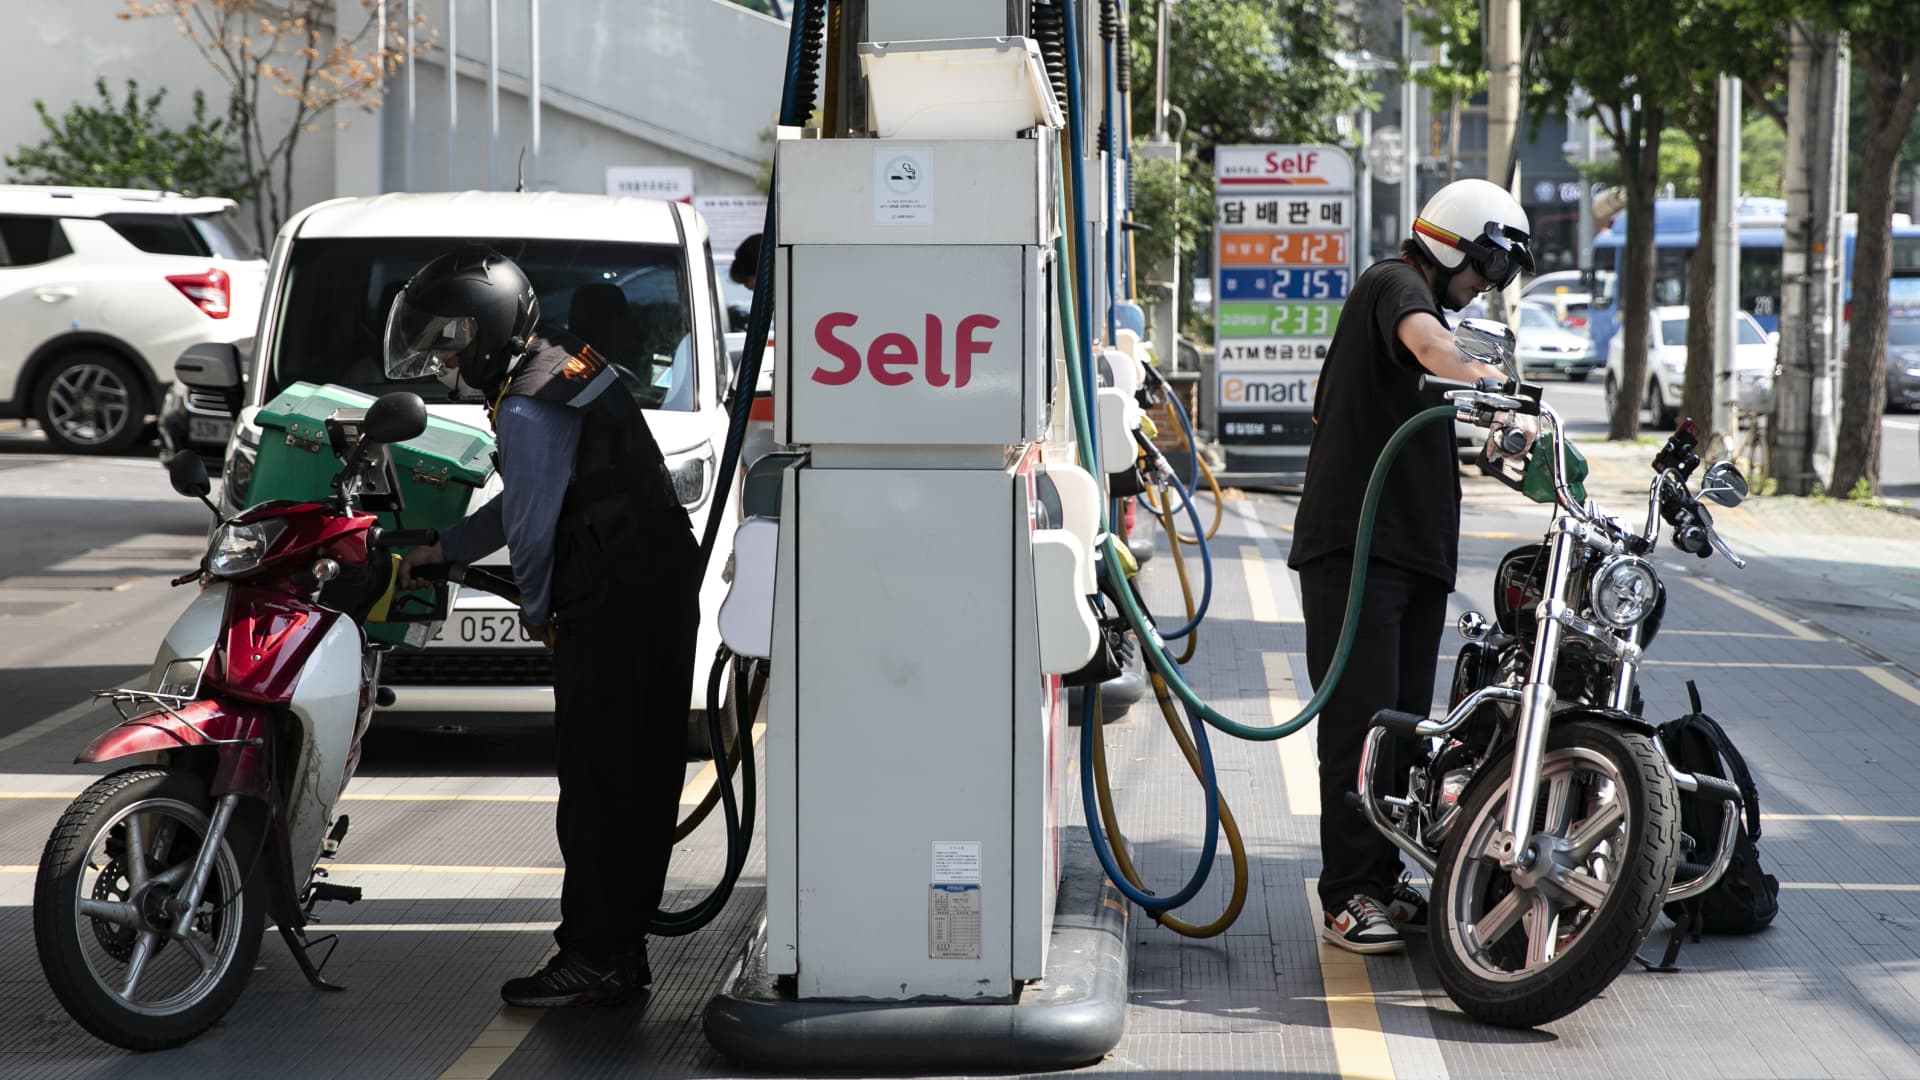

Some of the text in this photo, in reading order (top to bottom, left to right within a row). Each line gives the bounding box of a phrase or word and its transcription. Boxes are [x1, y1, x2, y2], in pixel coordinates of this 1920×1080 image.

[1265, 151, 1319, 174] Self
[1270, 234, 1345, 264] 2127
[1272, 269, 1348, 299] 2157
[1270, 305, 1343, 335] 233
[811, 311, 1001, 389] Self
[1223, 345, 1259, 360] ATM
[1224, 377, 1308, 402] emart
